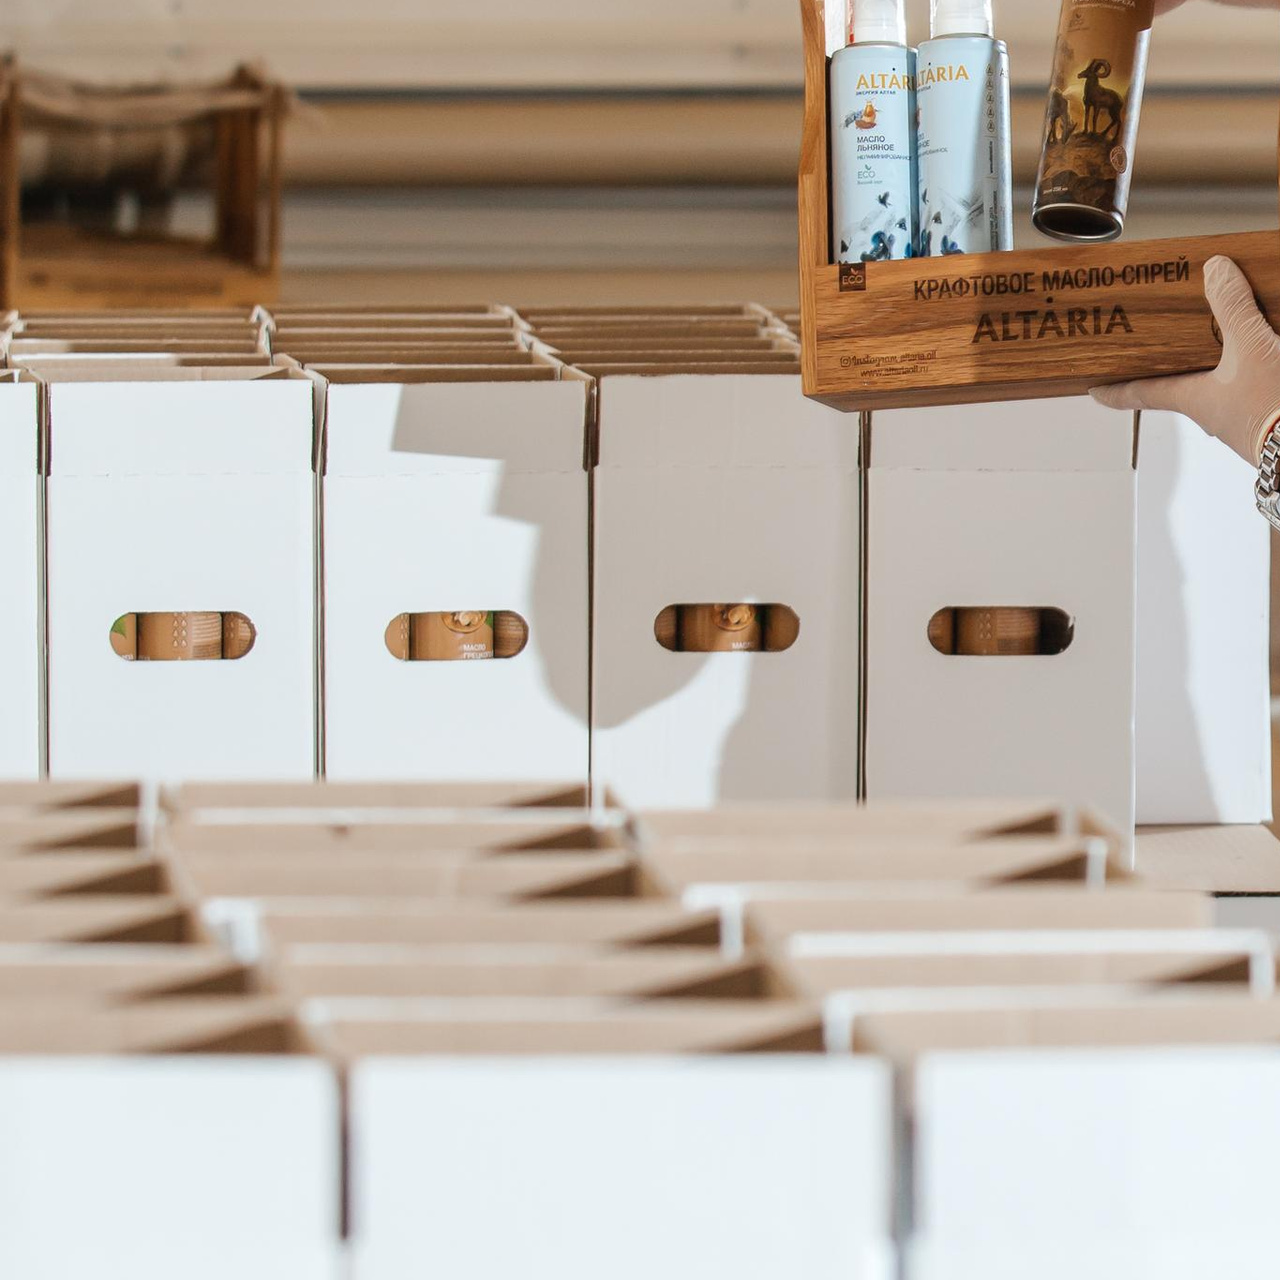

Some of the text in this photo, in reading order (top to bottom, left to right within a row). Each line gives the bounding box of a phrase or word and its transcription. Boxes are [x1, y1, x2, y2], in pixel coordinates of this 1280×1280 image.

[856, 135, 886, 144] МАСЛО
[856, 144, 894, 152] ЛЬНЯНОЕ
[842, 275, 863, 285] ECO
[914, 256, 1189, 301] КРАФТОВОЕ МАСЛО-СПРЕЙ
[971, 296, 1134, 343] ALTARIA
